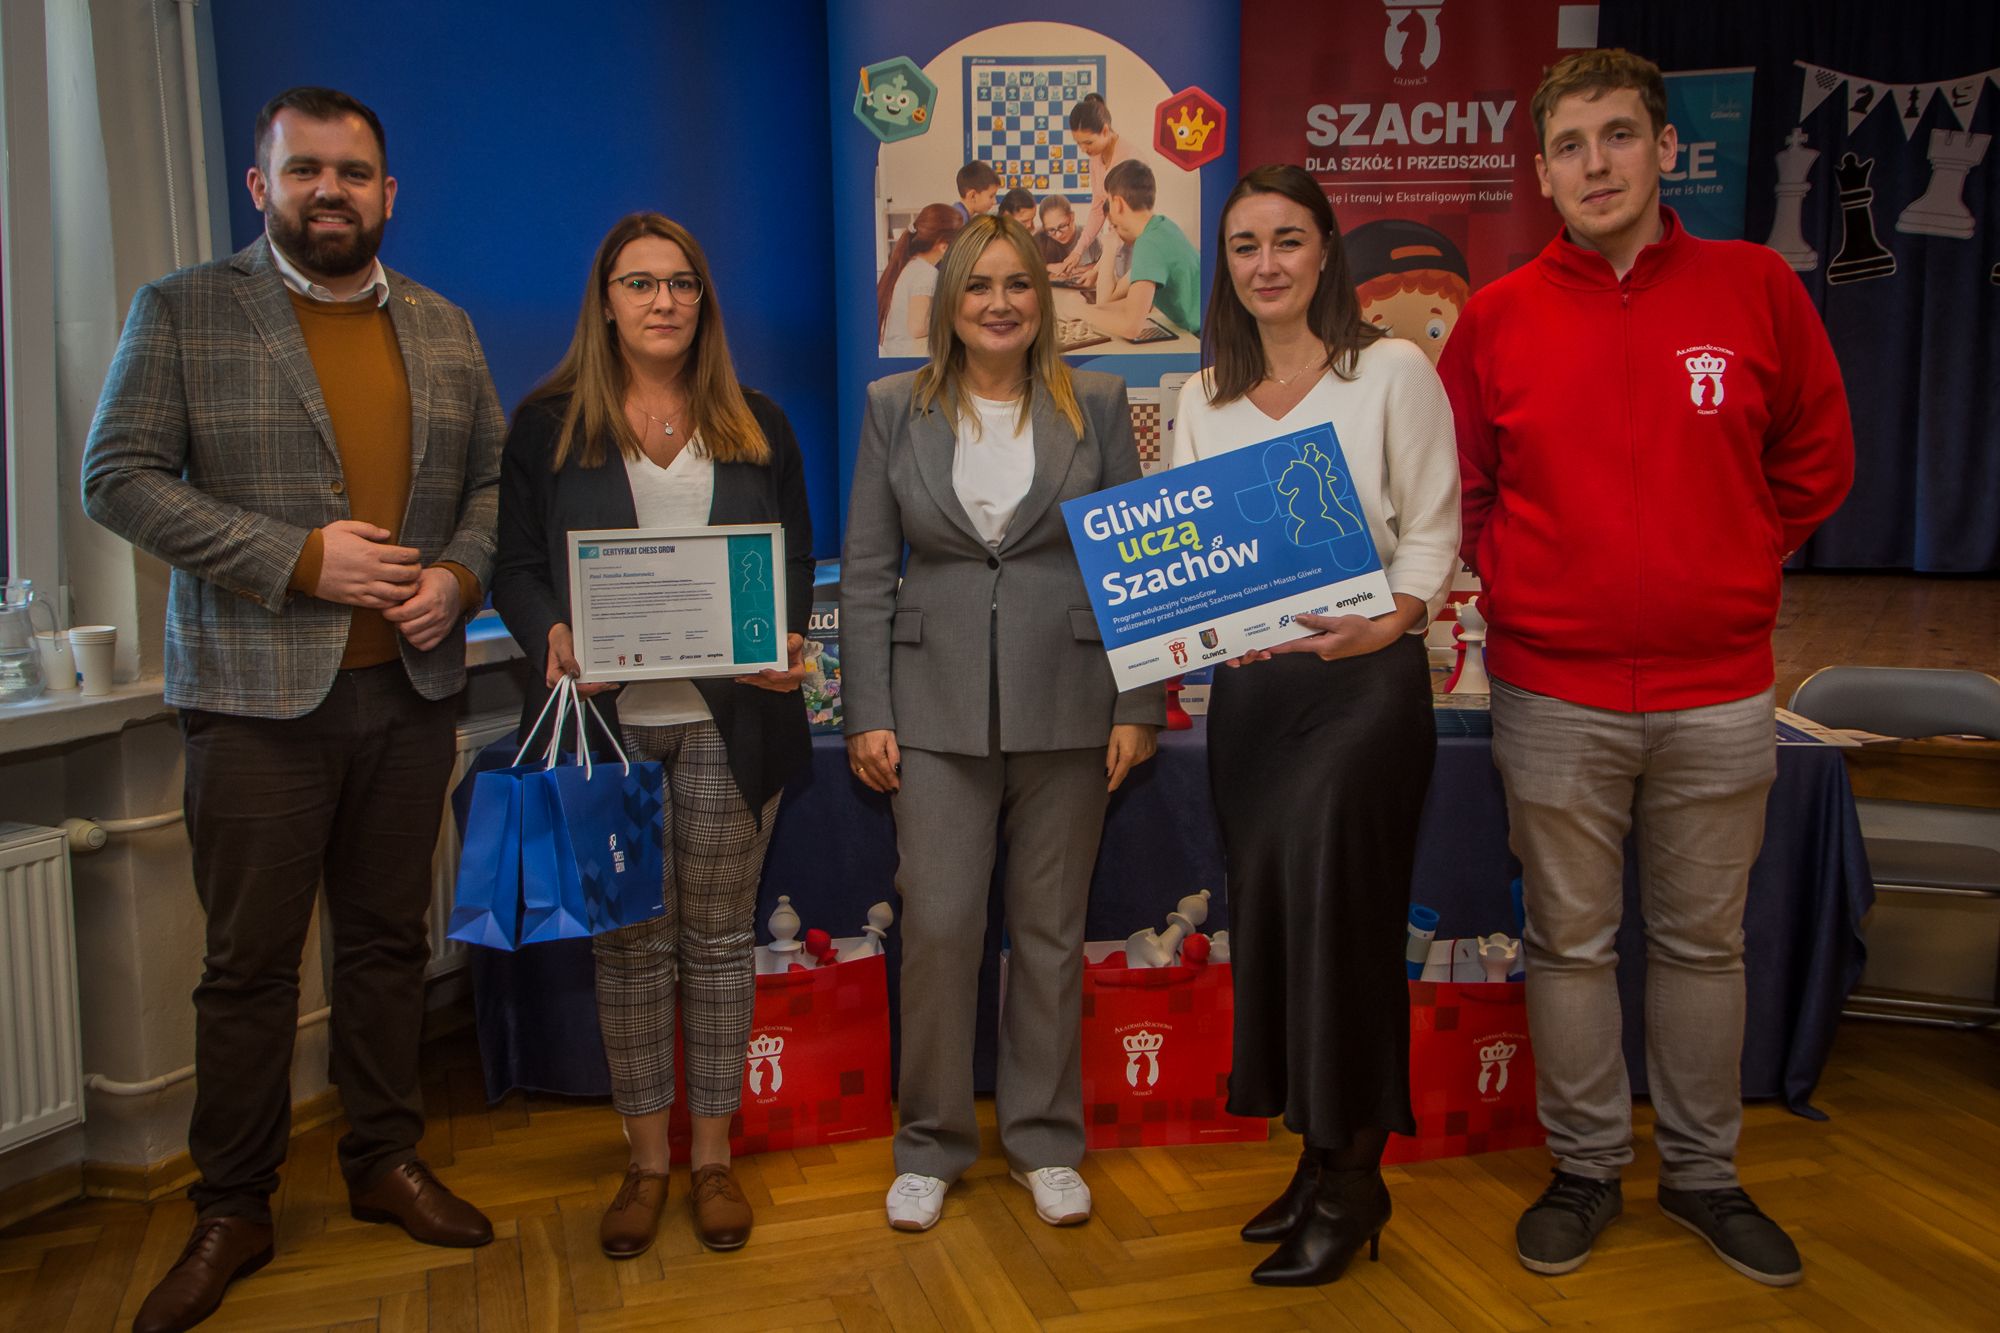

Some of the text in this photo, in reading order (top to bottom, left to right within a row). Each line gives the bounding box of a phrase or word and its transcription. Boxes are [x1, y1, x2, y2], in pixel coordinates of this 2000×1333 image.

[1393, 75, 1429, 86] GLIWICE
[1306, 101, 1517, 147] SZACHY
[1305, 153, 1516, 172] DLA SZKÓŁ I PRZEDSZKOLI
[1327, 190, 1514, 205] się i trenuj w Ekstraligowym Klubie
[1685, 184, 1694, 195] is
[1696, 183, 1724, 194] here
[1083, 485, 1214, 541] Gliwice
[602, 545, 676, 557] CERTYFIKAT CHESS GROW
[1117, 520, 1204, 564] uczą
[1102, 534, 1259, 606] Szachów
[1112, 588, 1217, 625] Program edukacyjny ChessGrow
[1115, 617, 1156, 634] realizowany
[1156, 611, 1175, 623] przez
[1175, 600, 1209, 616] Akademię
[1208, 591, 1243, 606] Szachową
[1243, 582, 1268, 595] Gliwice
[1273, 575, 1297, 586] Miasto
[1297, 567, 1322, 579] Gliwice
[753, 623, 759, 637] 1
[1201, 648, 1228, 661] GLIWICE
